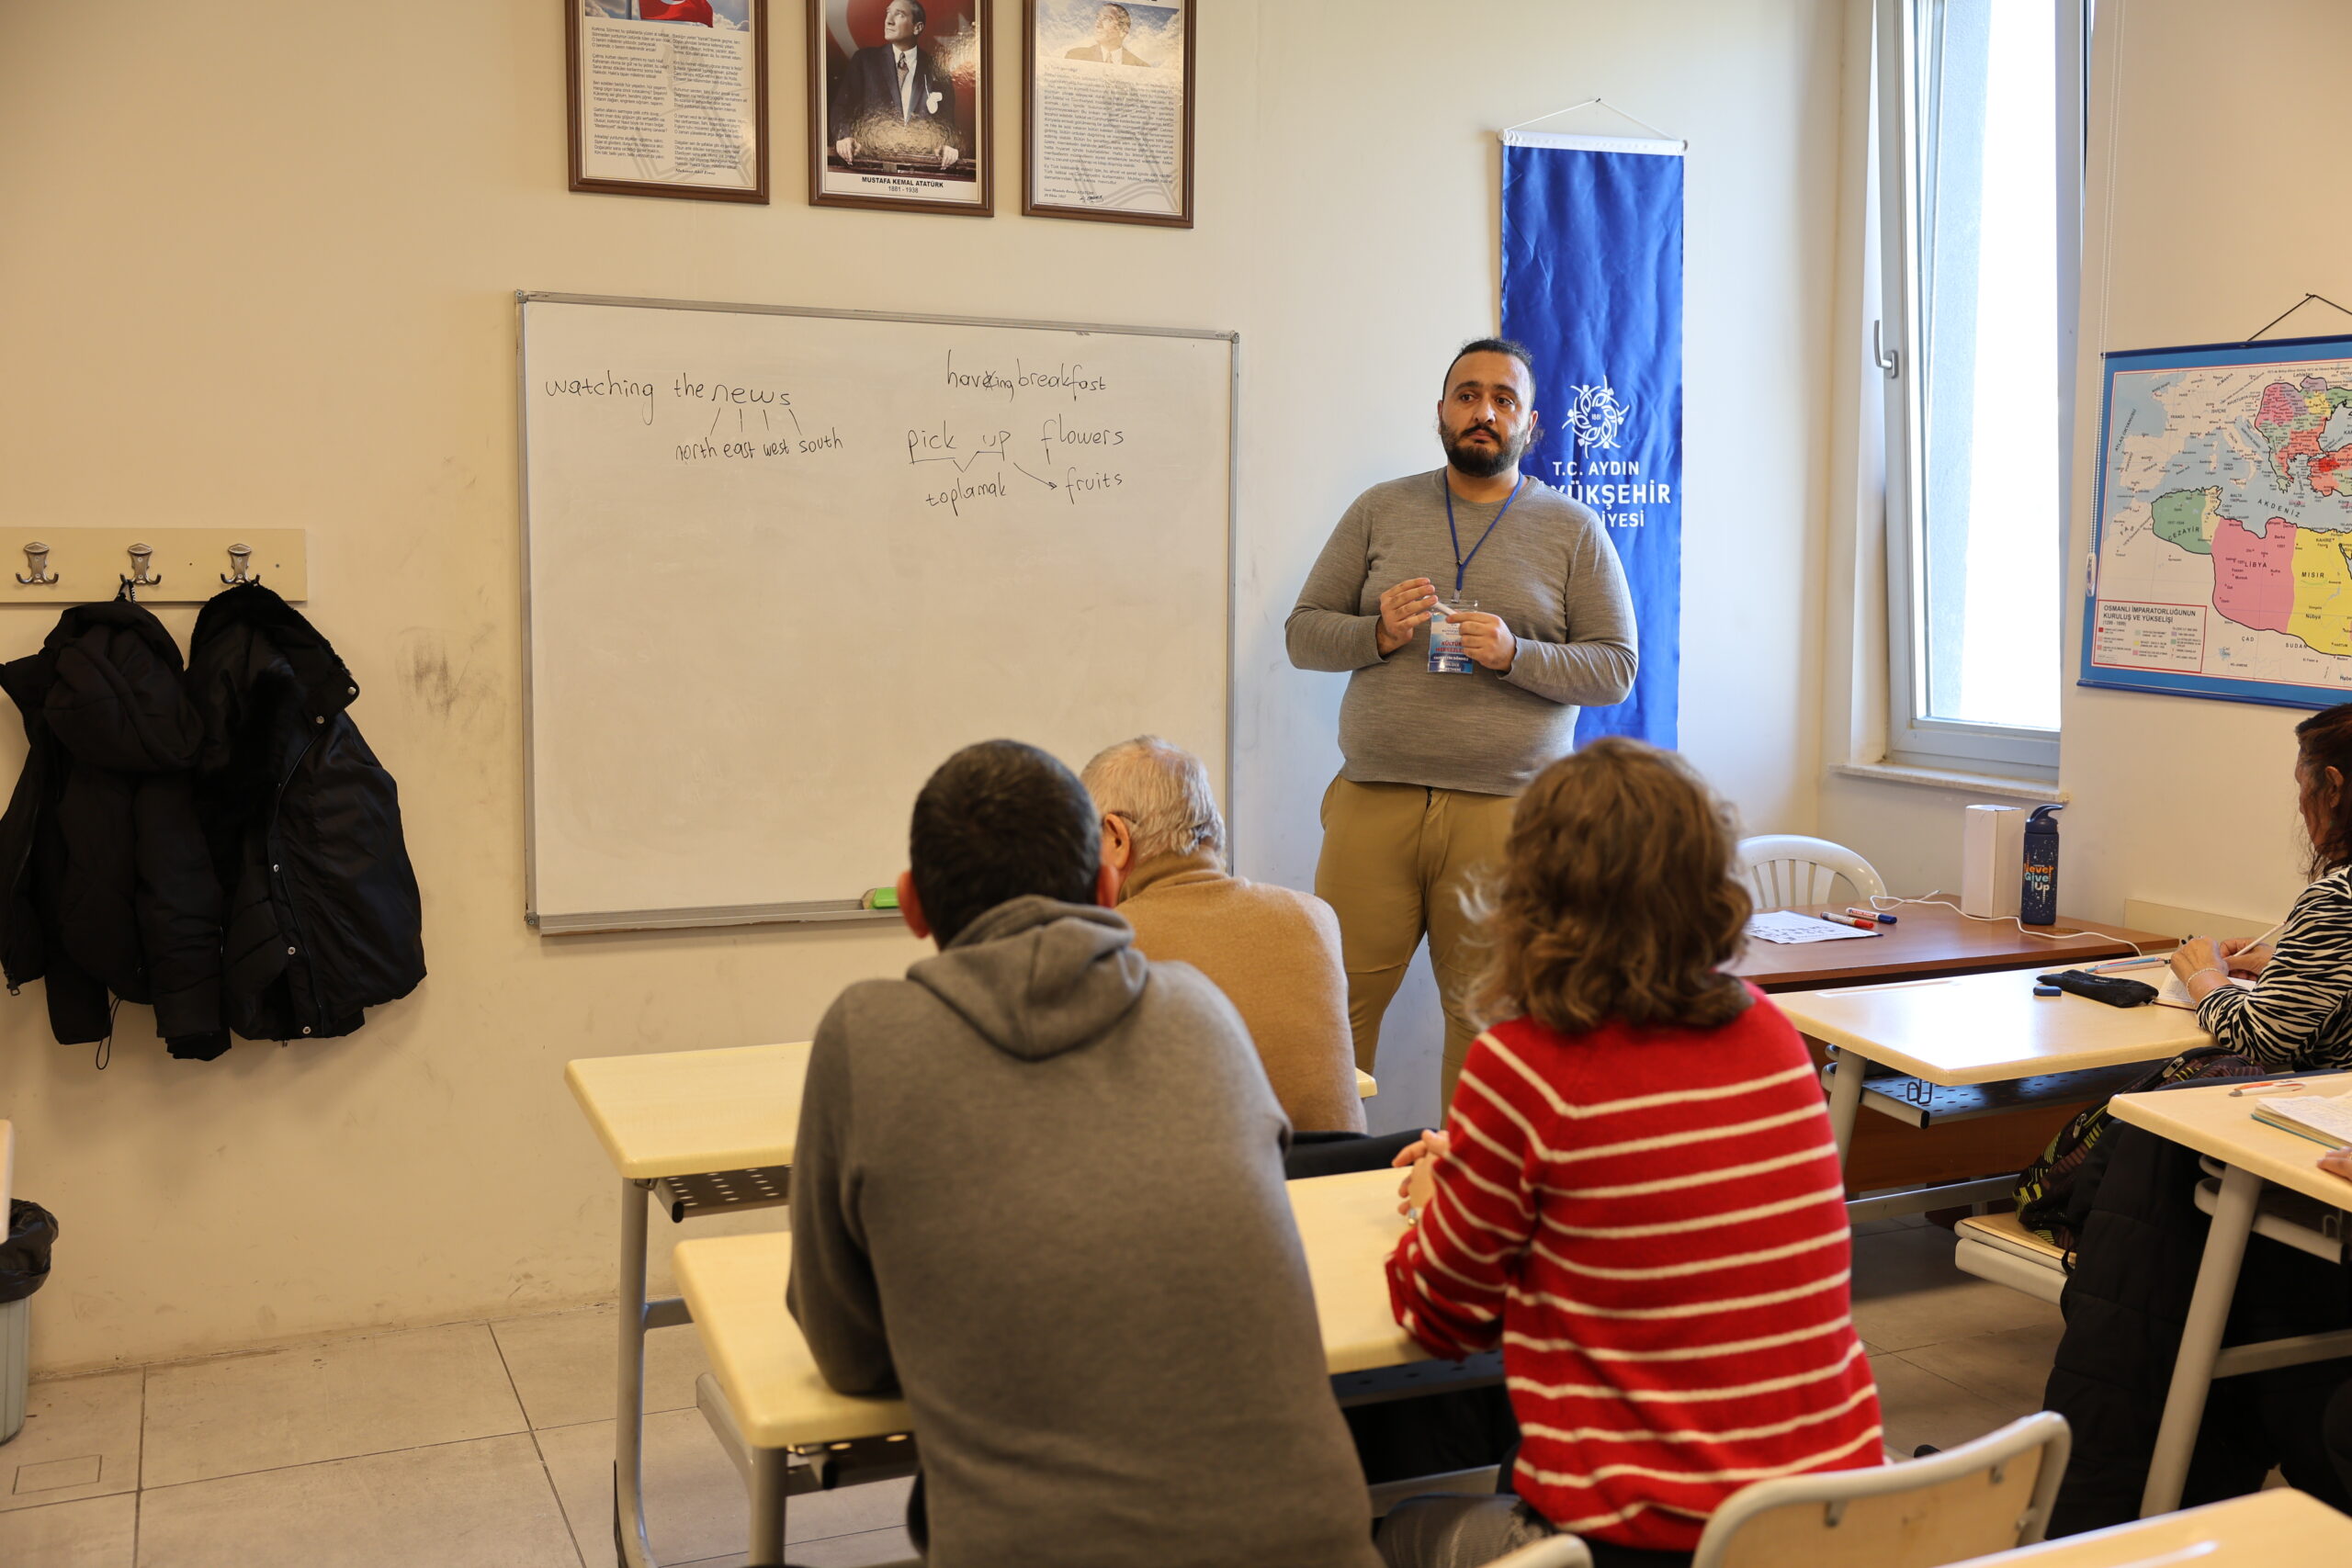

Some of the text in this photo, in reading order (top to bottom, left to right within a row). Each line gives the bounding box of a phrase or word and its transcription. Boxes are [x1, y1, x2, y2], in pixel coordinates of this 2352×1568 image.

[862, 176, 944, 188] MUSTAFA KEMAL ATATÜRK
[545, 369, 791, 425] watching the news
[675, 427, 843, 463] north east west south
[908, 412, 1125, 465] pick up flowers
[1553, 460, 1640, 476] T.C. AYDIN
[925, 471, 1007, 516] toplamak
[1065, 466, 1123, 505] fruits
[2258, 499, 2301, 518] AKDENİZ
[2168, 527, 2199, 542] CEZAYİR
[2132, 605, 2196, 616] İMPARATORLUĞUNUN
[2143, 615, 2174, 624] YÜKSELİŞİ
[2025, 872, 2049, 882] Give
[2035, 882, 2051, 896] Up
